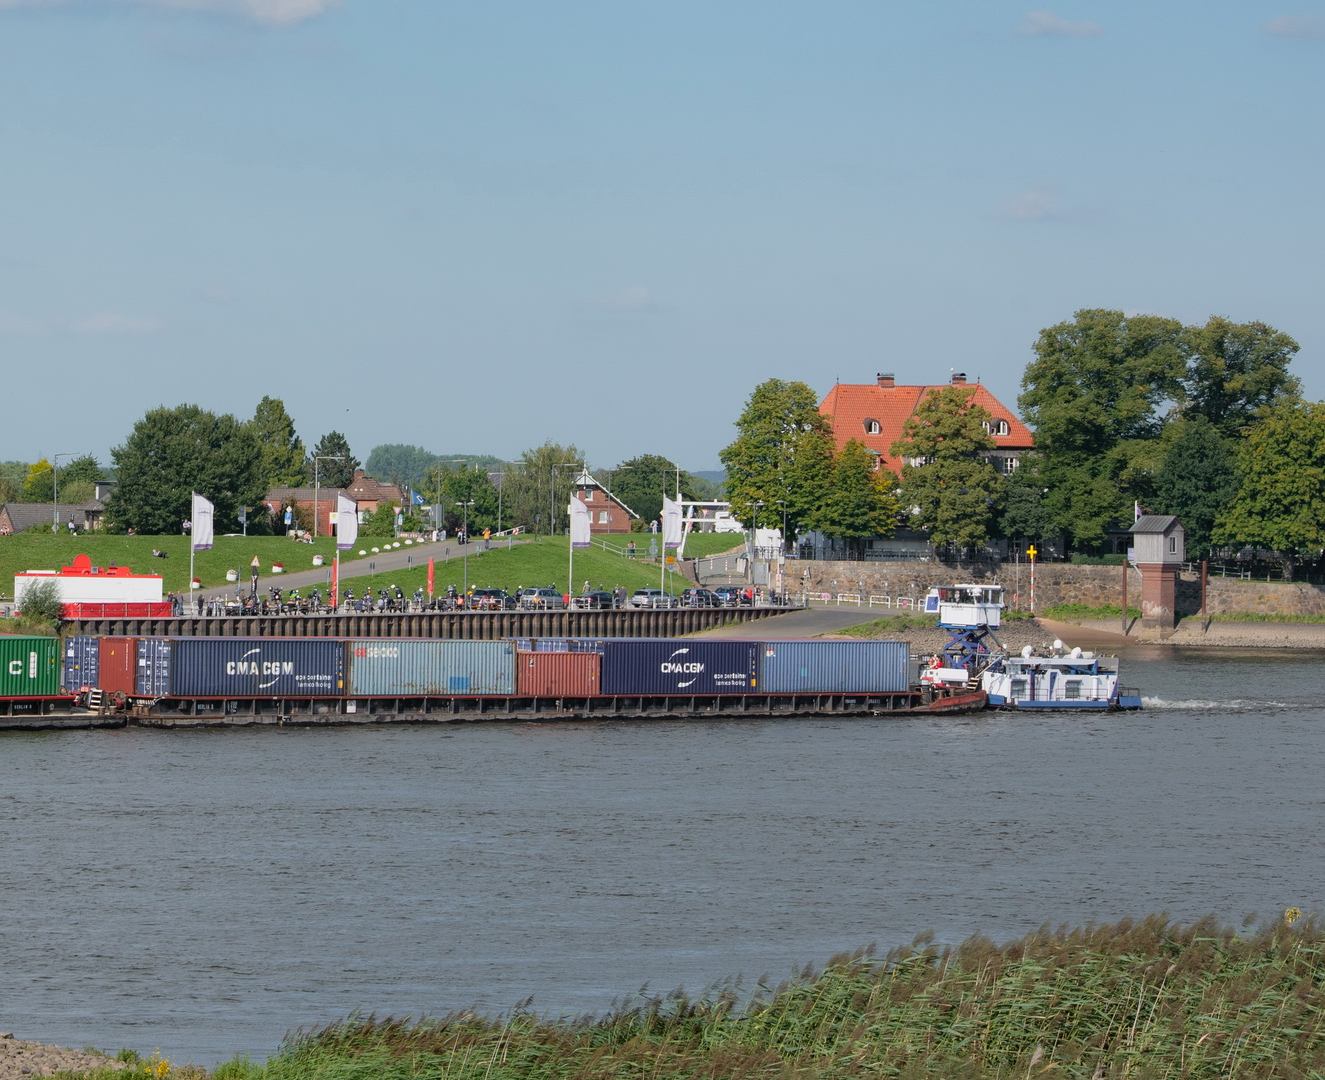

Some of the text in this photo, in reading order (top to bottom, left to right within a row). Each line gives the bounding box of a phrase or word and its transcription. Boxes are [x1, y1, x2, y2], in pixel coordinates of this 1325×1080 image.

[226, 661, 294, 675] CMA CGM
[661, 662, 705, 673] CMA CGM
